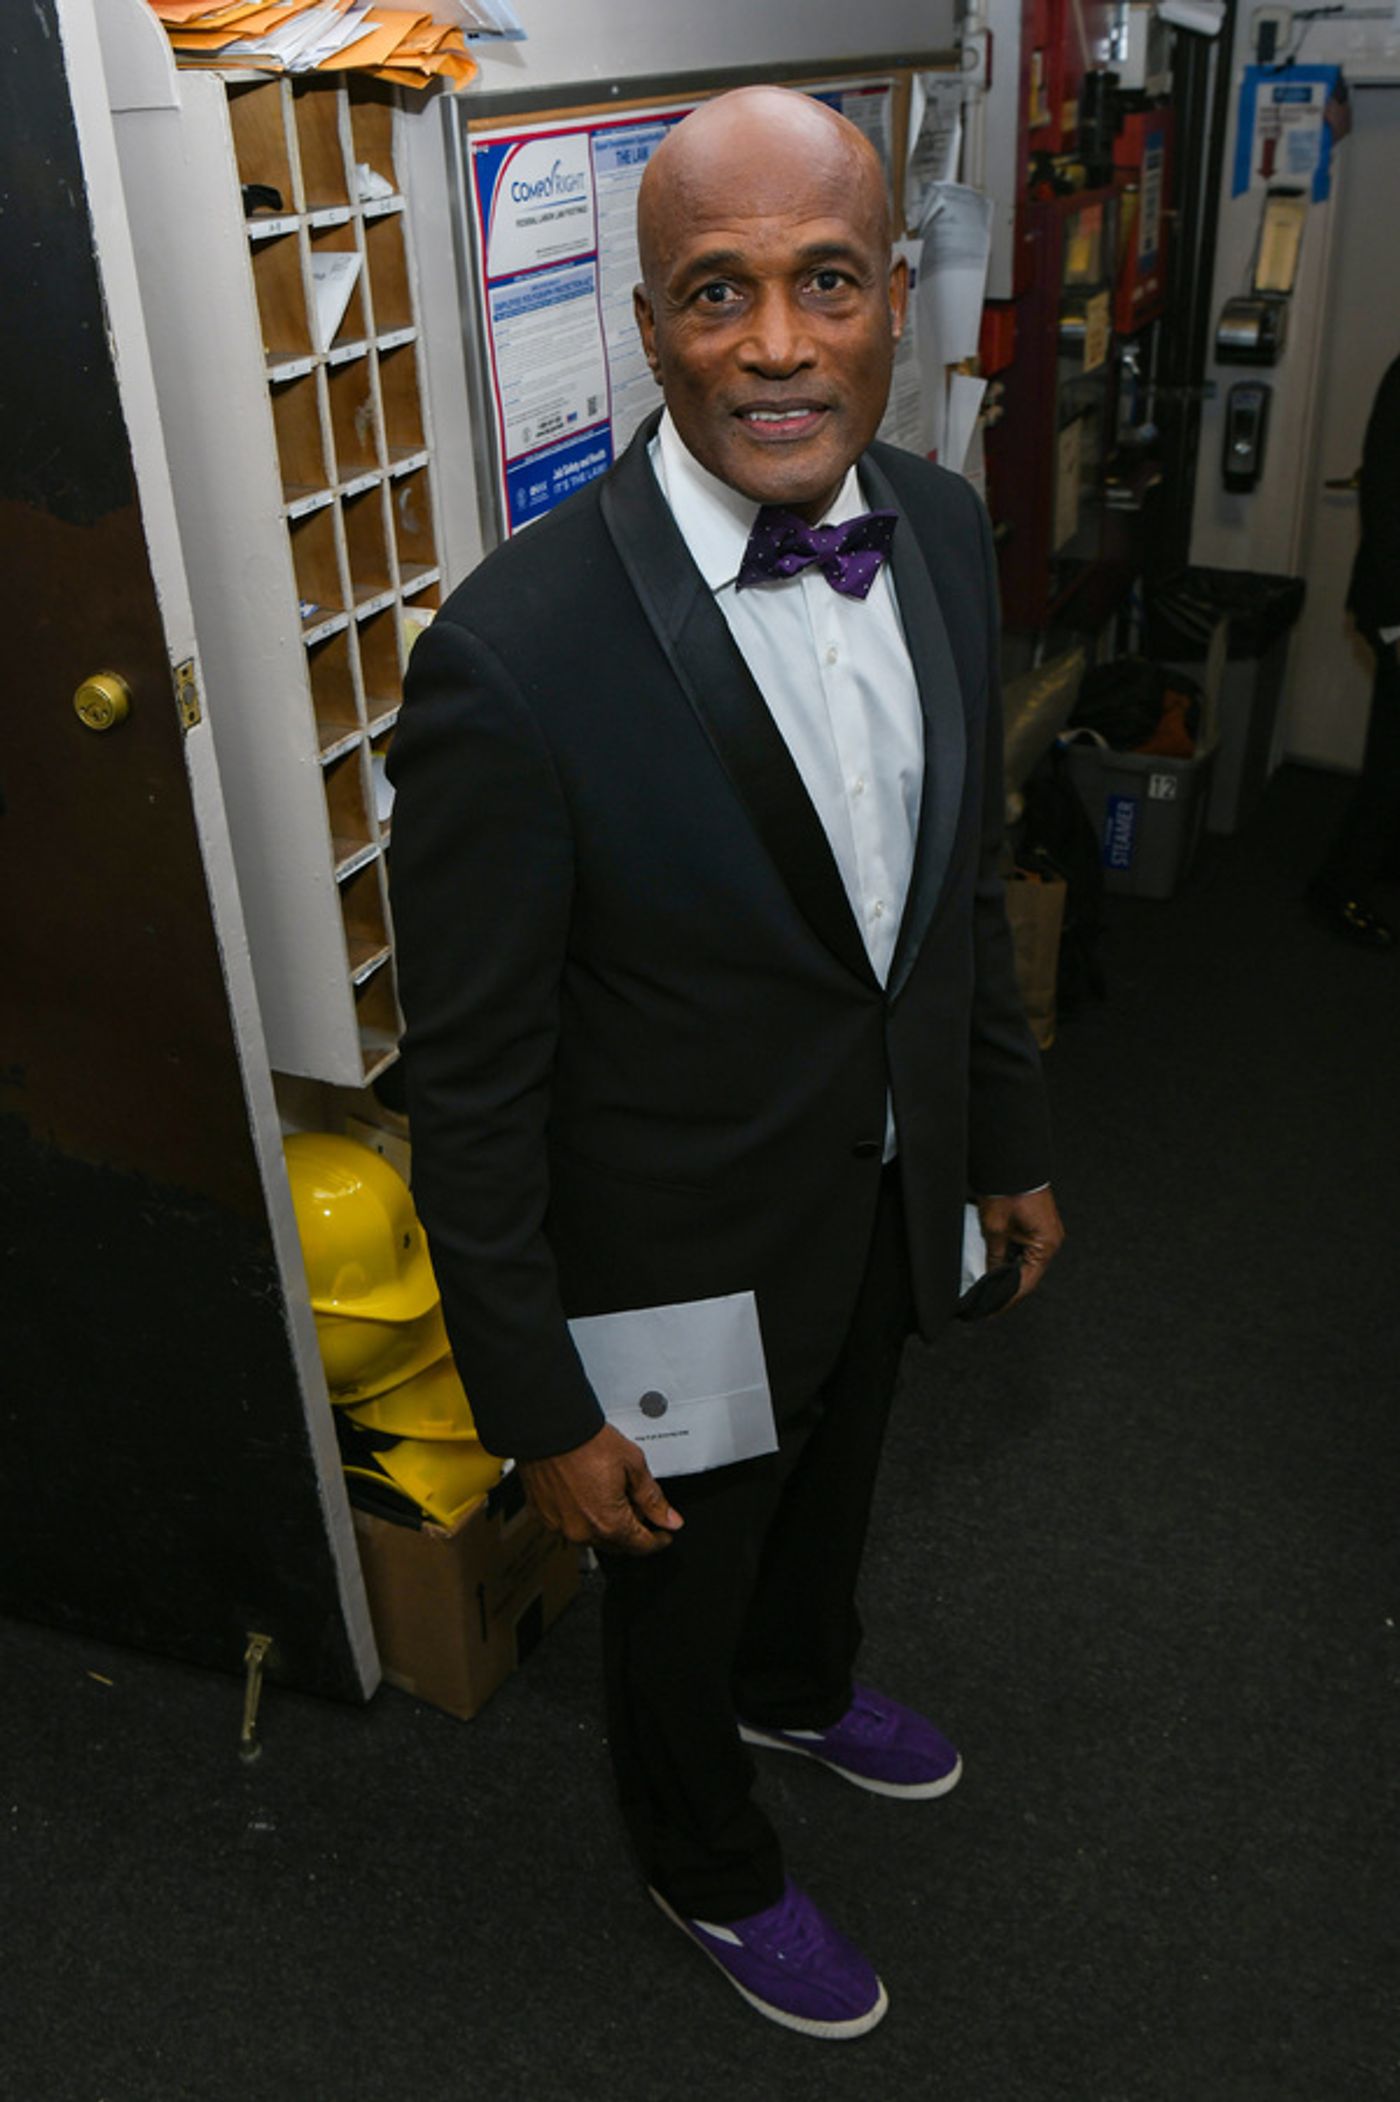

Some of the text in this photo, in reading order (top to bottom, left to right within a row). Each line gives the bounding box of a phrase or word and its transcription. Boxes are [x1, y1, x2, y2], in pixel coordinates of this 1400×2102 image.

[615, 145, 650, 167] THE LAW
[1153, 775, 1177, 799] 12
[1111, 802, 1135, 865] STEAMER
